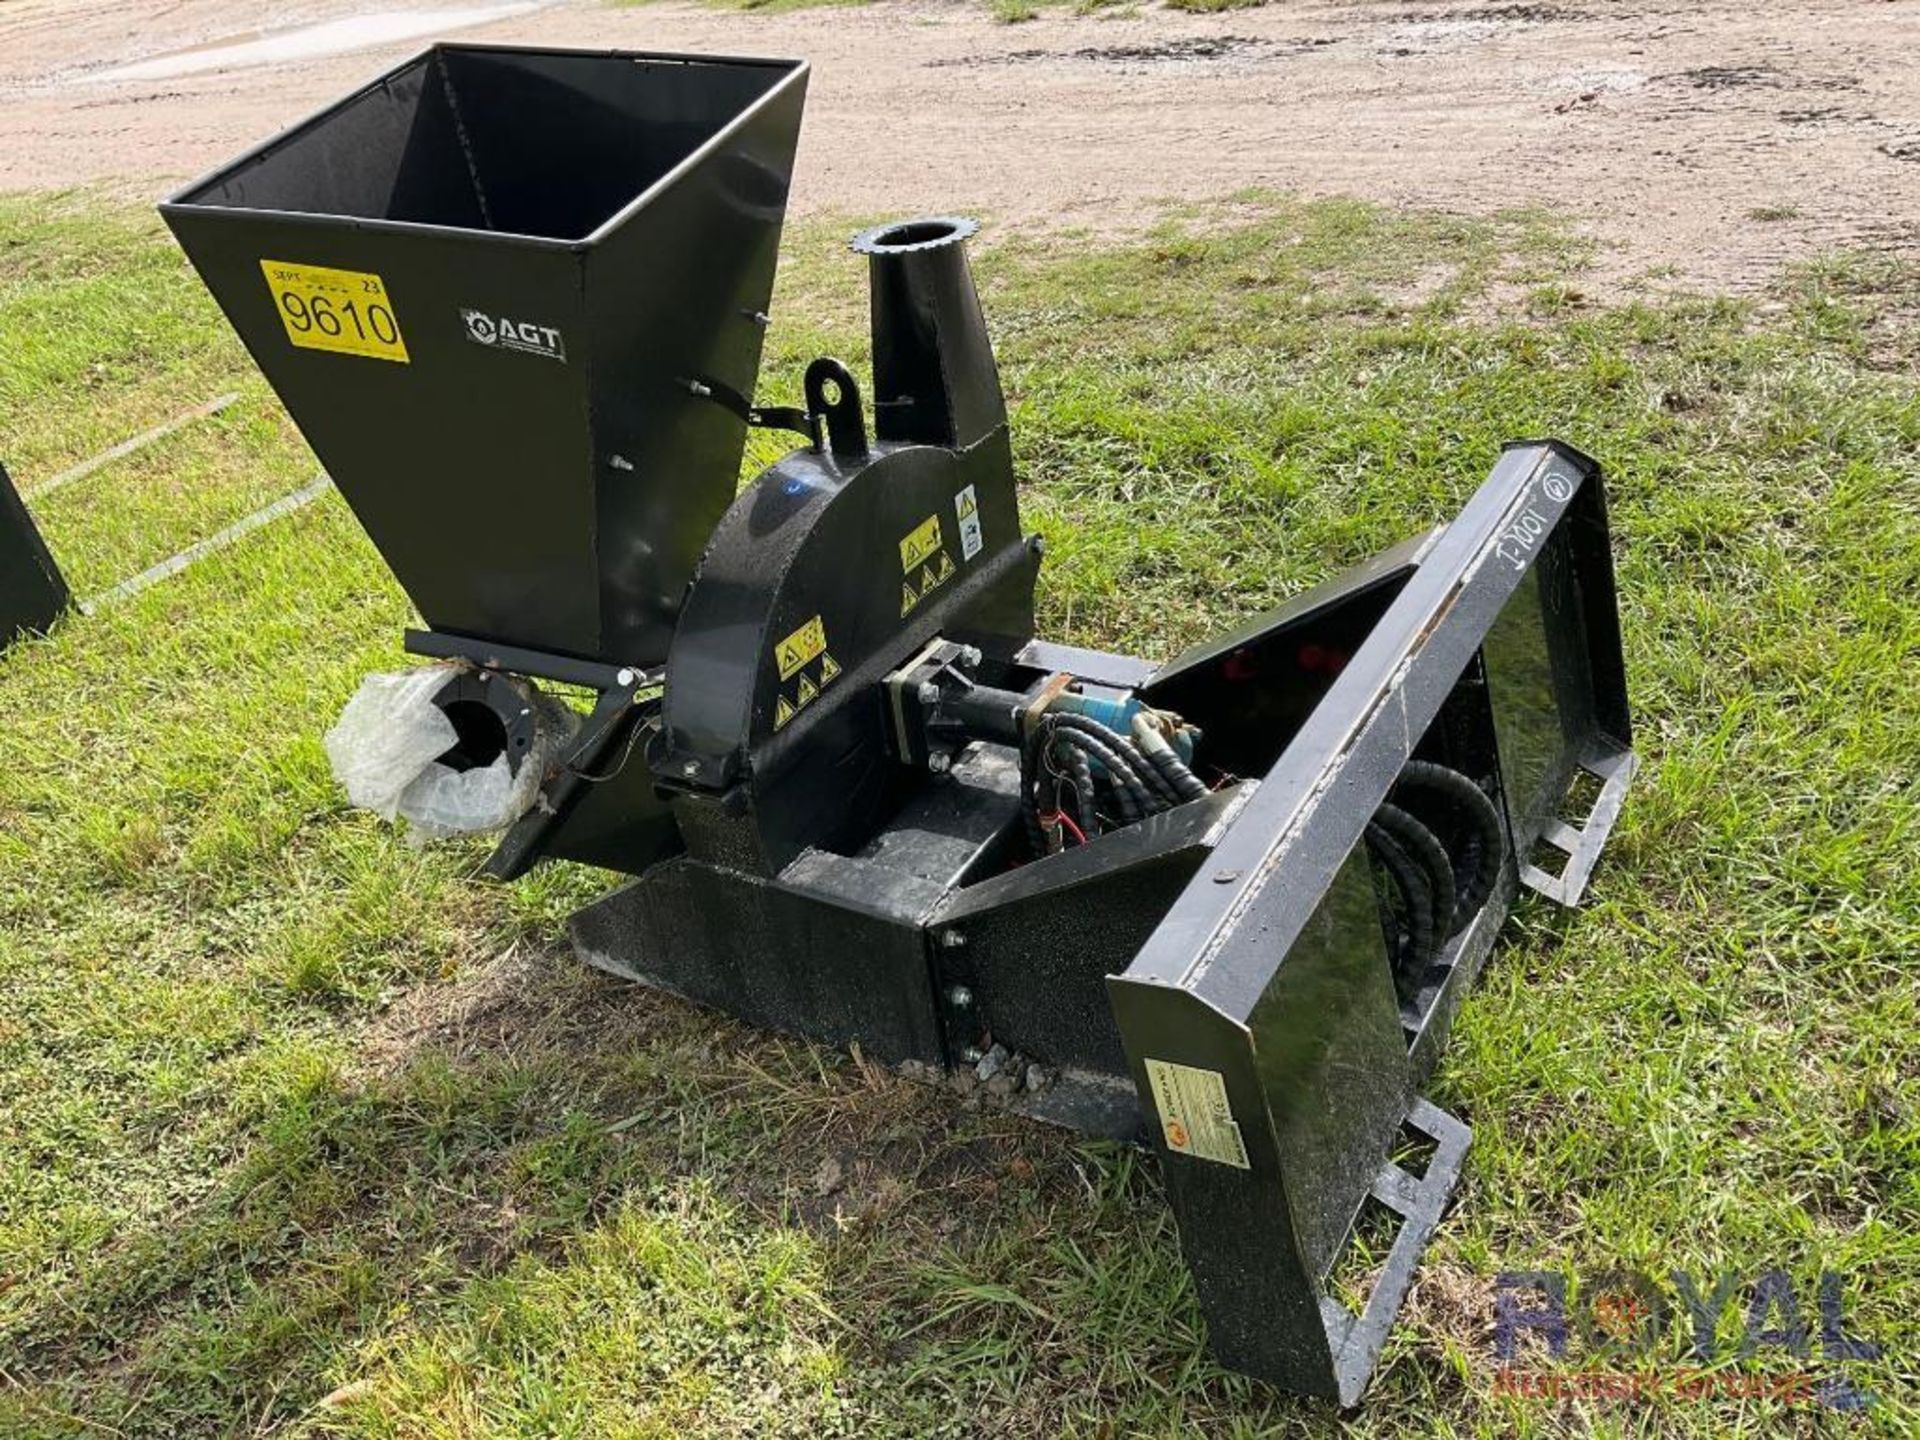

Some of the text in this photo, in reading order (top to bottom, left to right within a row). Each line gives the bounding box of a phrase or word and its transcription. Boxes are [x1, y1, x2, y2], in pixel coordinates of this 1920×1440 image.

[361, 280, 380, 294] 23
[281, 291, 398, 345] 9610
[500, 317, 560, 348] AGT
